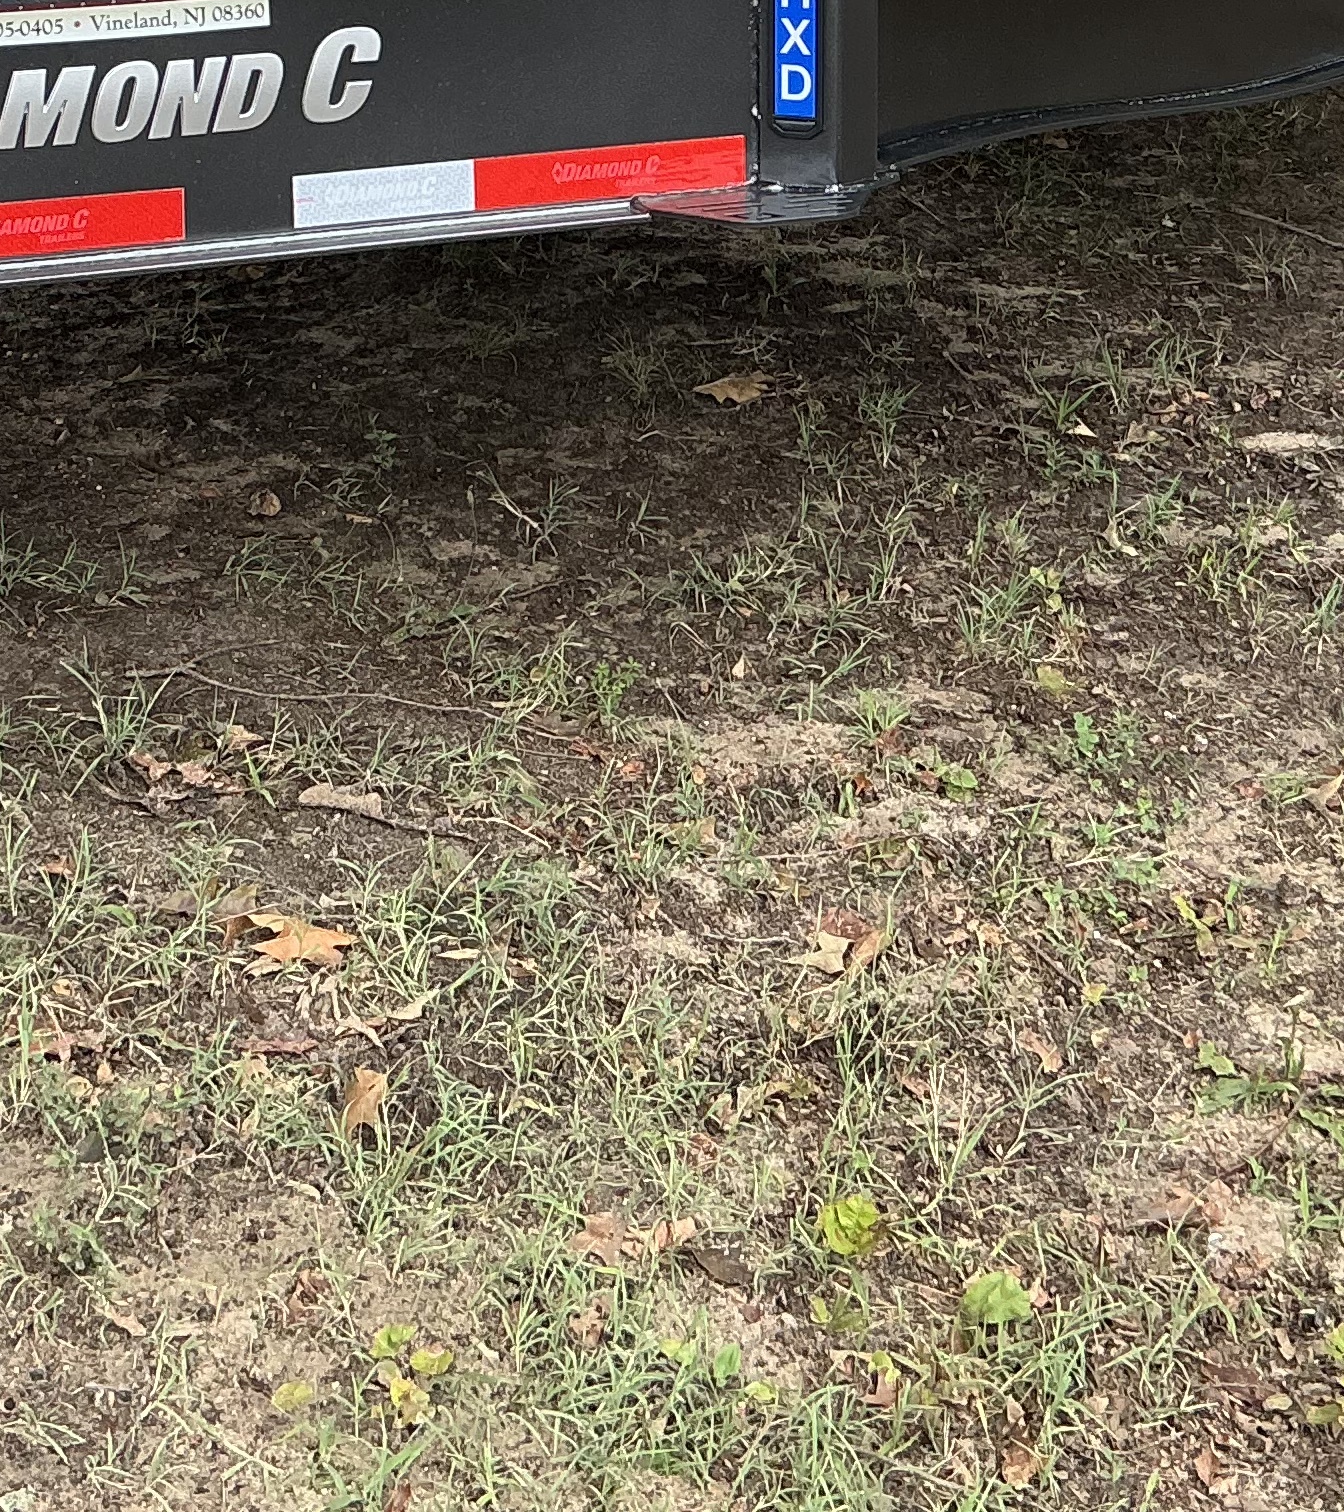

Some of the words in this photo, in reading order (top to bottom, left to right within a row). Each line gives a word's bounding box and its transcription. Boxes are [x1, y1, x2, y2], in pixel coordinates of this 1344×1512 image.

[89, 9, 178, 32] Vineland,
[183, 6, 206, 28] NJ
[212, 2, 265, 23] 08360
[301, 25, 383, 124] C
[560, 159, 643, 184] DIAMOND
[645, 155, 661, 175] C
[73, 207, 91, 229] C
